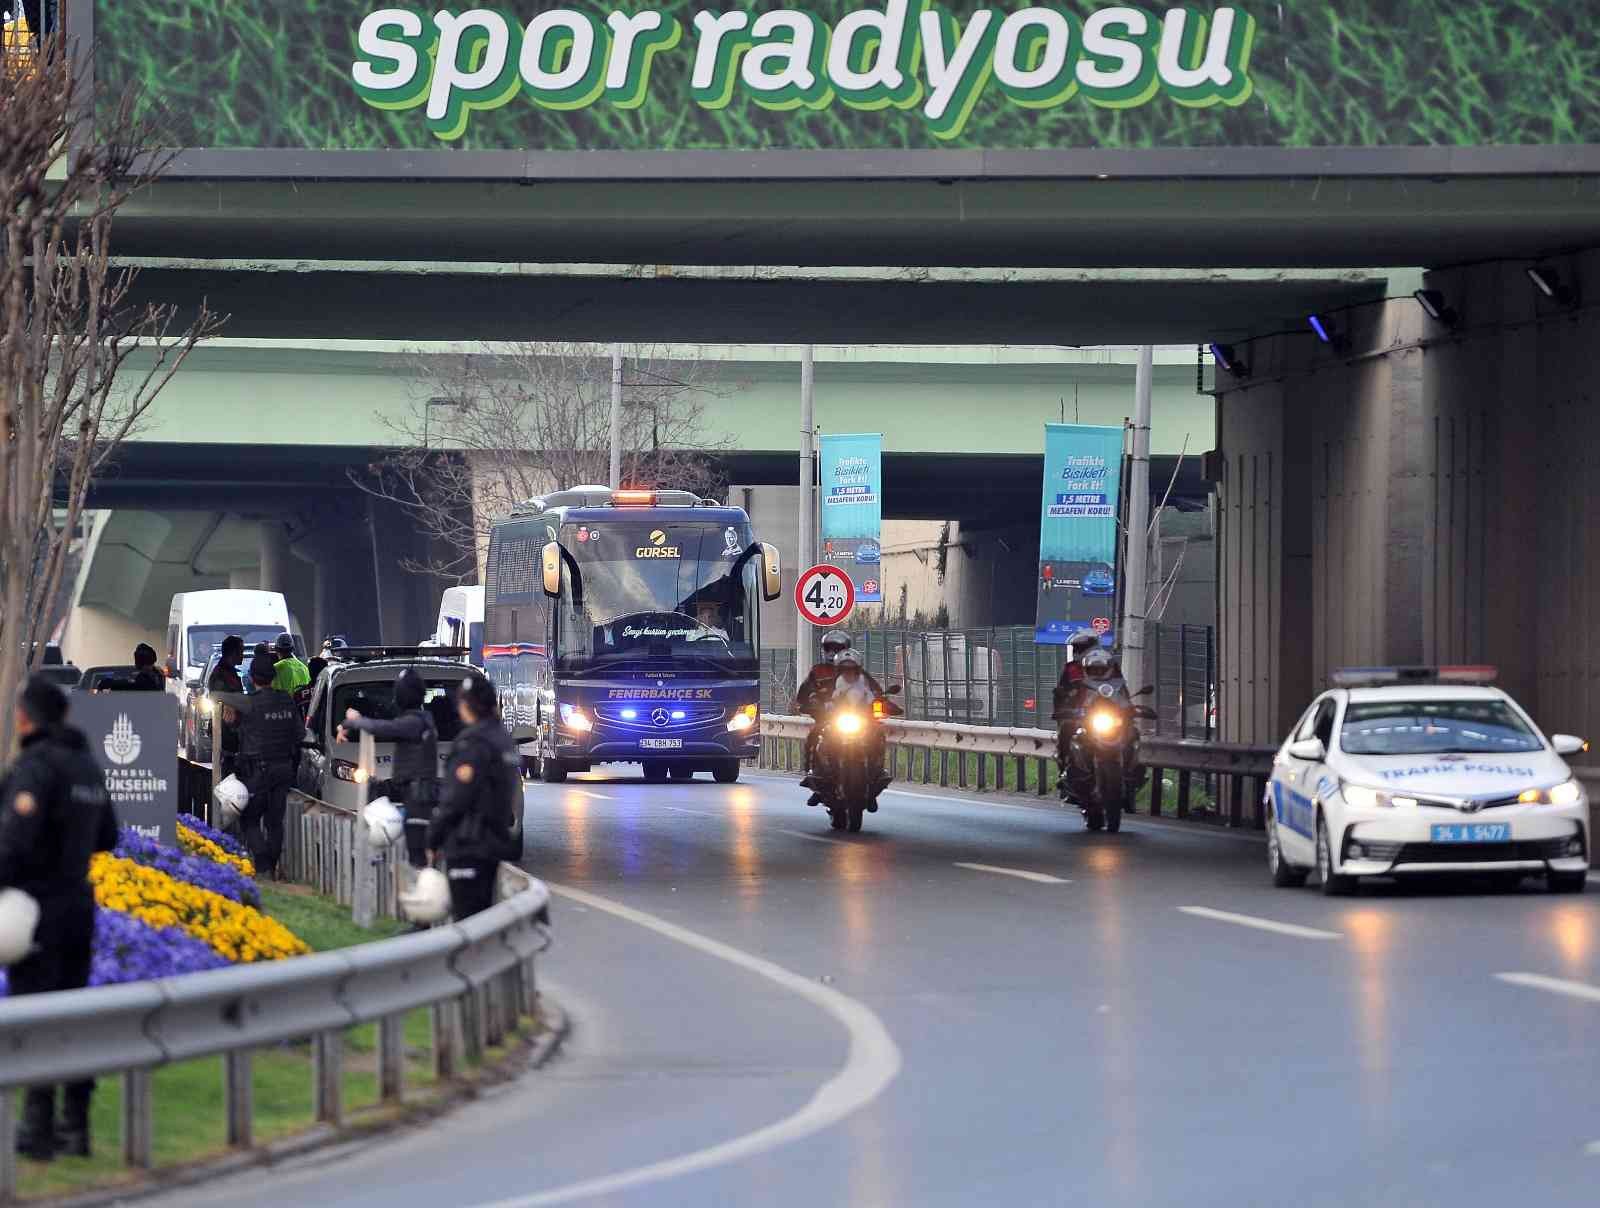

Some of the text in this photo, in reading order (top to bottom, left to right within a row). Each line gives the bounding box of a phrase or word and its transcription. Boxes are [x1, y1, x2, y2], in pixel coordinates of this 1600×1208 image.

[352, 0, 1236, 124] spor radyosu
[608, 689, 713, 701] FENERBAHÇE SK
